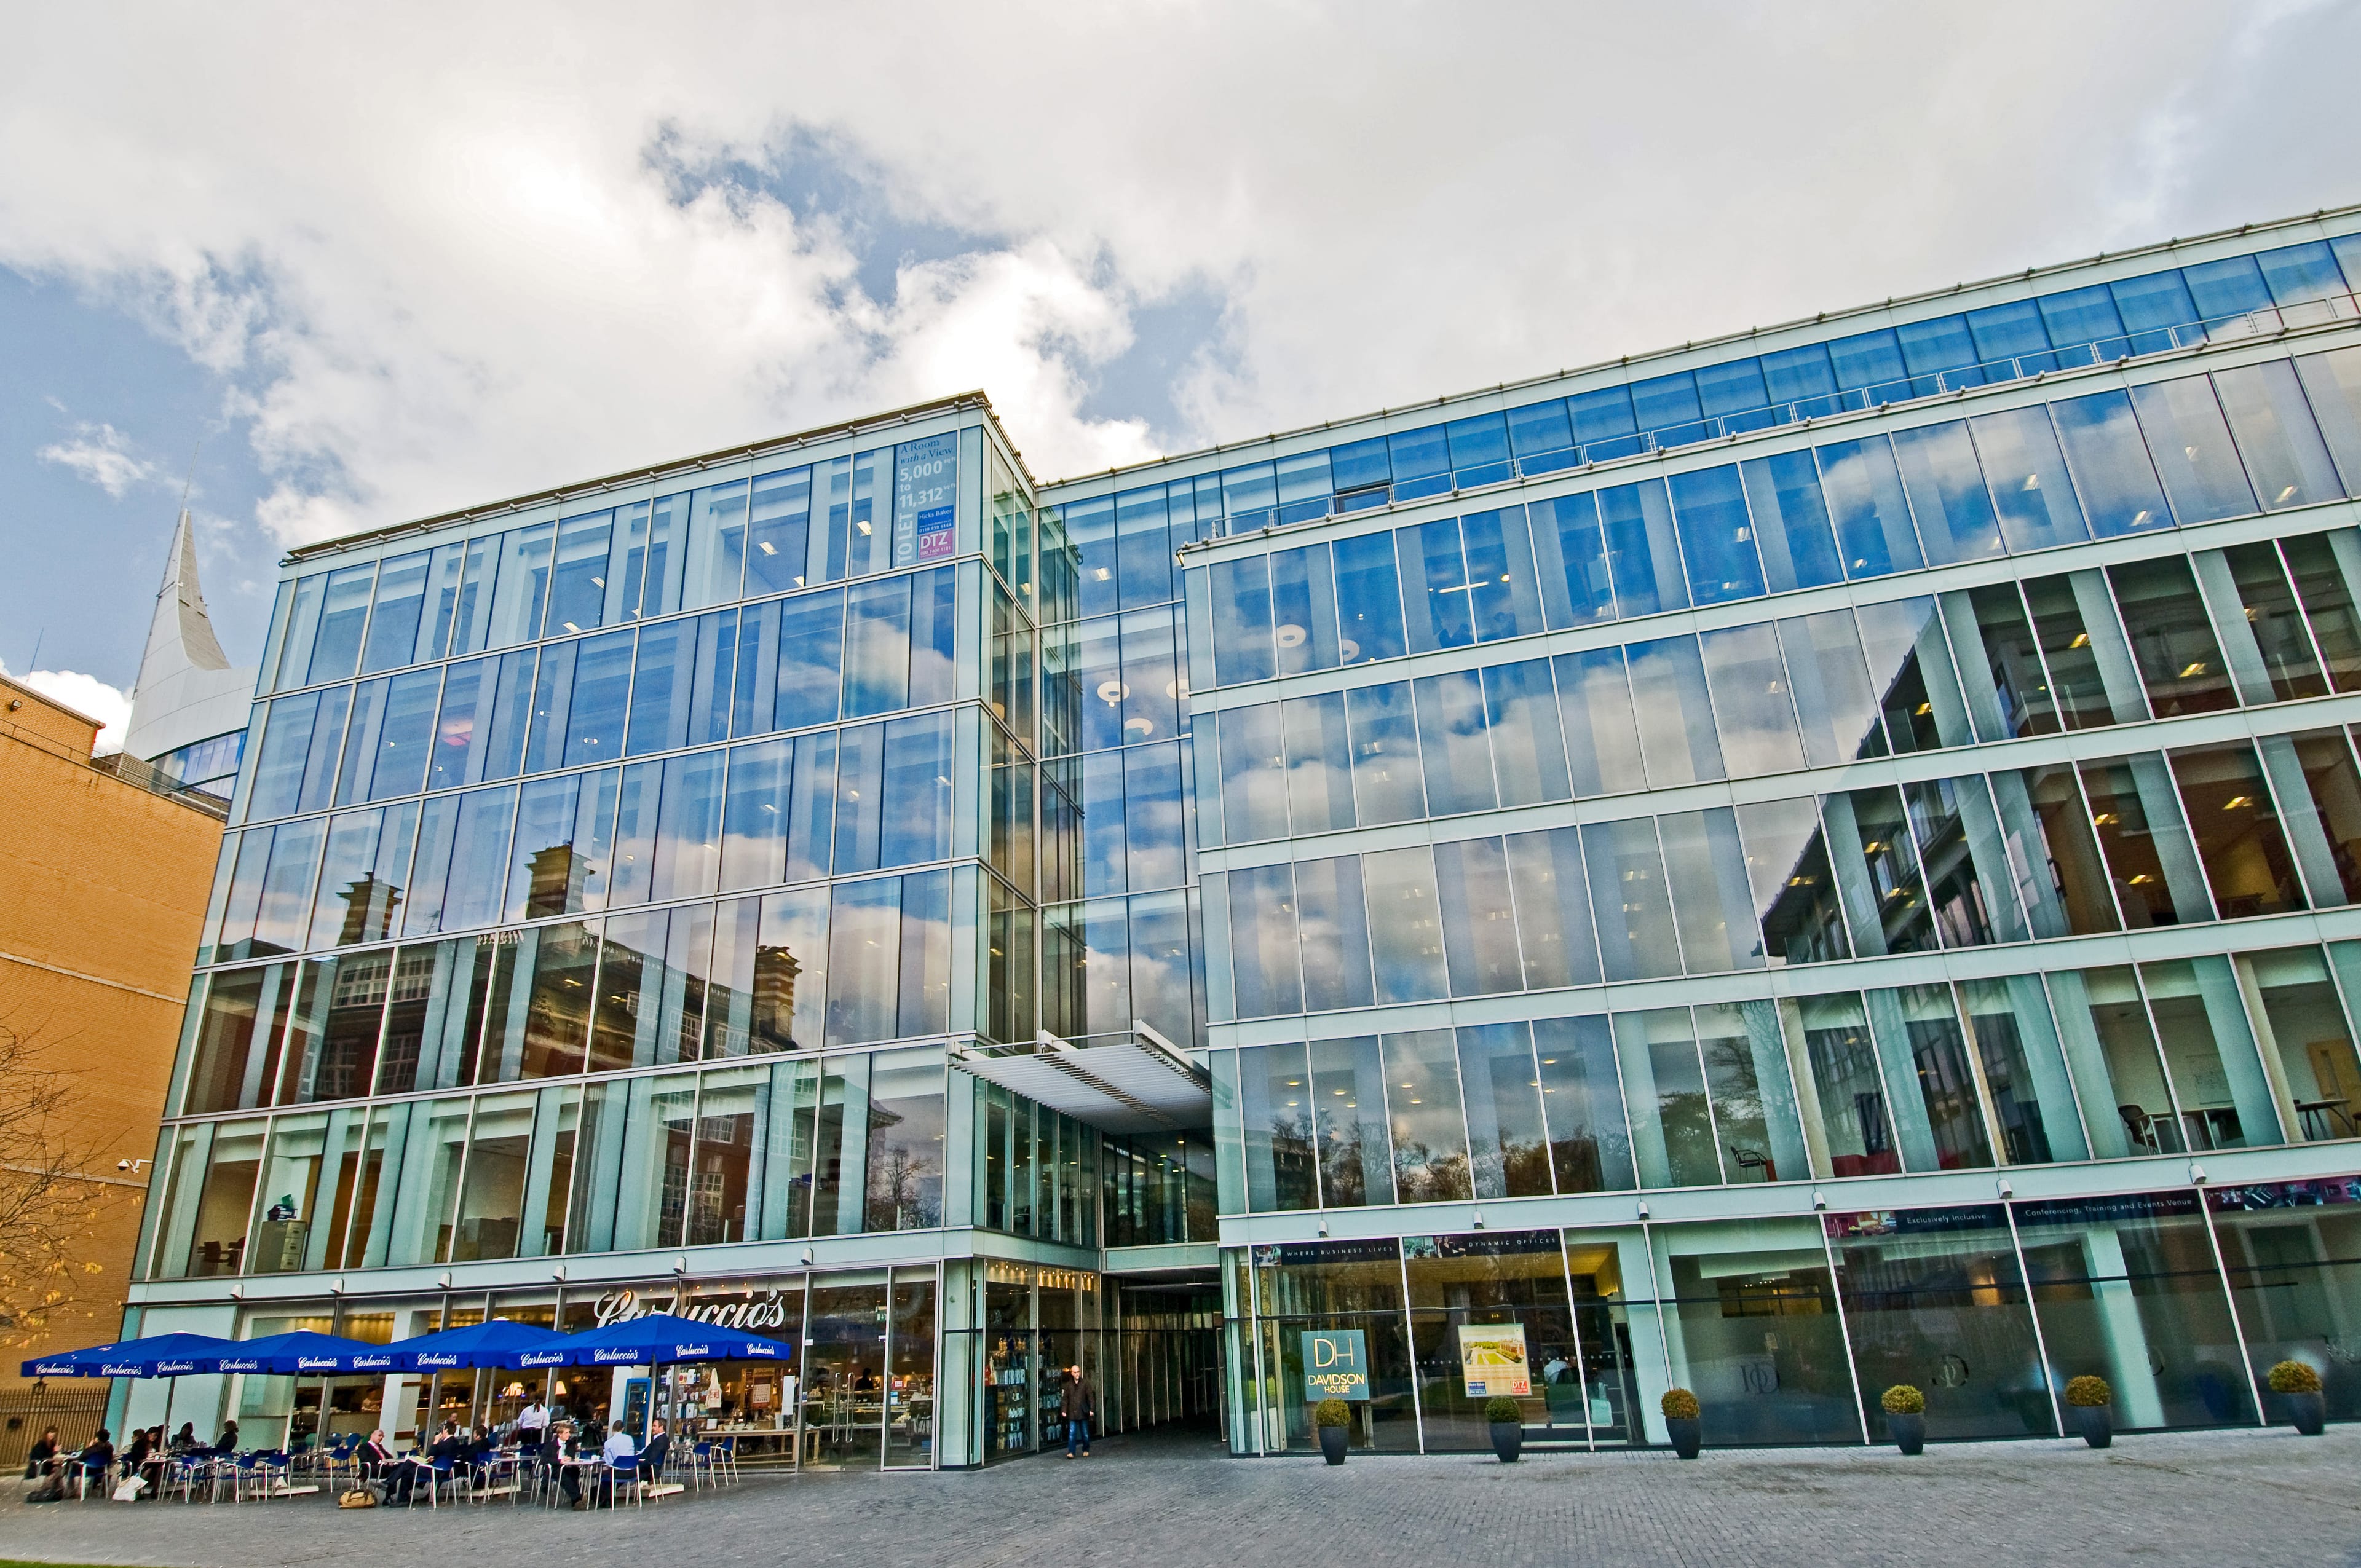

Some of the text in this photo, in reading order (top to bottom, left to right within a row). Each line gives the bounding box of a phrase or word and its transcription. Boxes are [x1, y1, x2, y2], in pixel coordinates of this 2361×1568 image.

[901, 439, 940, 454] A Room
[900, 453, 919, 464] with
[928, 447, 953, 457] View
[900, 460, 943, 481] 5,000
[900, 487, 943, 508] 11,312
[920, 531, 947, 549] DTZ
[1907, 1215, 1949, 1224] Exclusively
[594, 1347, 639, 1362] Carluccio's
[676, 1343, 709, 1358] Carluccio's
[746, 1342, 775, 1356] Carluccio's
[1314, 1337, 1354, 1368] DH
[219, 1358, 258, 1371] Carluccio's
[298, 1355, 338, 1368] Carluccio's
[352, 1354, 392, 1368] Carluccio's
[417, 1352, 457, 1366] Carluccio's
[520, 1352, 564, 1366] Carluccio's
[36, 1362, 74, 1374] Carluccio's
[101, 1363, 143, 1376] Carluccio's
[157, 1360, 194, 1373] Carluccio's
[1308, 1373, 1365, 1385] DAVIDSON
